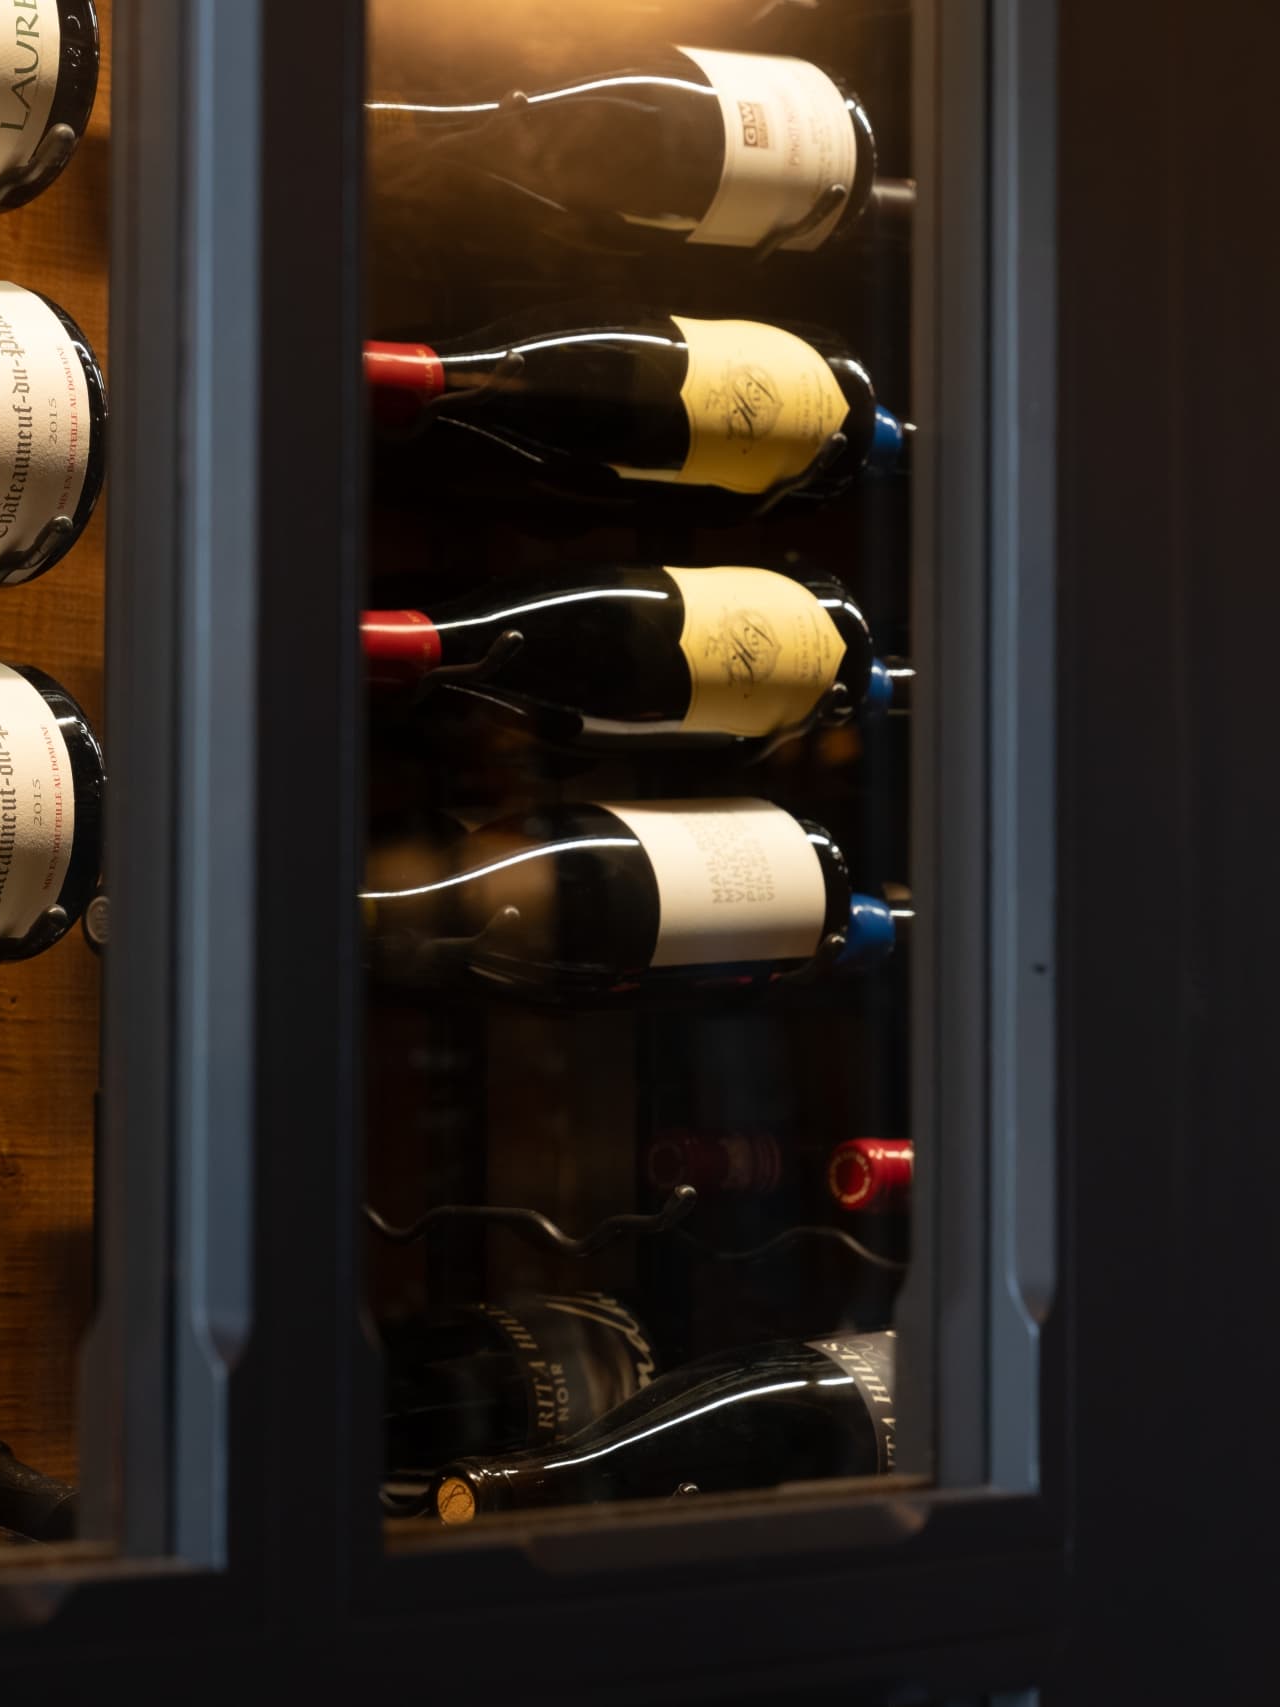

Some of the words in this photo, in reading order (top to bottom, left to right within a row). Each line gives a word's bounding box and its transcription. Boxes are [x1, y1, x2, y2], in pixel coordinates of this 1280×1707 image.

[47, 397, 58, 445] 2015
[69, 393, 78, 409] AU
[40, 725, 60, 771] DOMAINE
[32, 778, 42, 826] 2015
[54, 774, 63, 789] AU
[536, 1359, 556, 1429] RITA
[555, 1361, 571, 1423] NOIR
